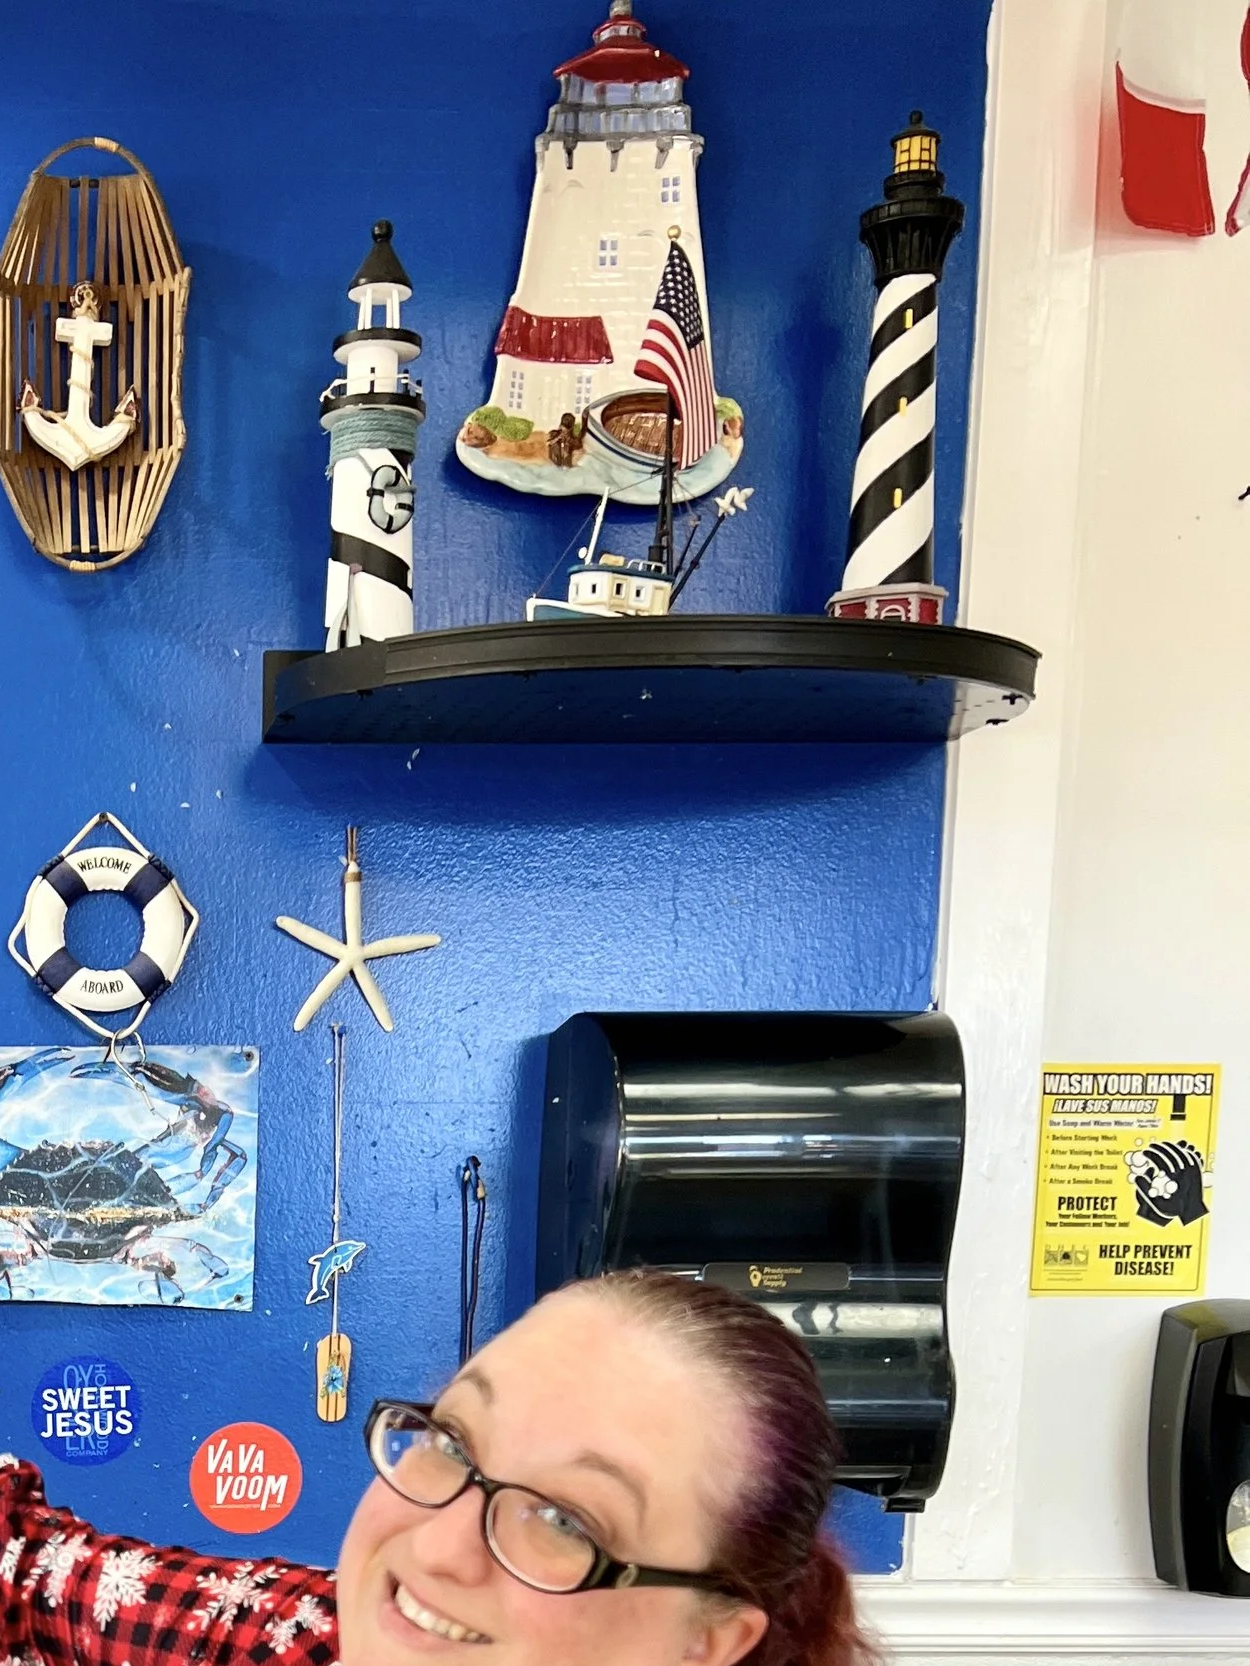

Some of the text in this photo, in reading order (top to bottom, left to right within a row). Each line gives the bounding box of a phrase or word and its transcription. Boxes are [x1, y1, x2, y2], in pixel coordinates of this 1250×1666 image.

[77, 857, 132, 874] WELCOME
[80, 979, 124, 994] ABOARD
[1044, 1073, 1213, 1096] WASH YOUR HANDS!
[1085, 1099, 1111, 1113] SUS
[1058, 1196, 1117, 1211] PROTECT
[1099, 1245, 1192, 1259] HELP PREVENT
[1114, 1261, 1175, 1276] DISEASE!
[42, 1385, 131, 1411] SWEET
[40, 1410, 133, 1438] JESUS
[207, 1439, 264, 1474] VA VA
[216, 1474, 288, 1511] VOOM
